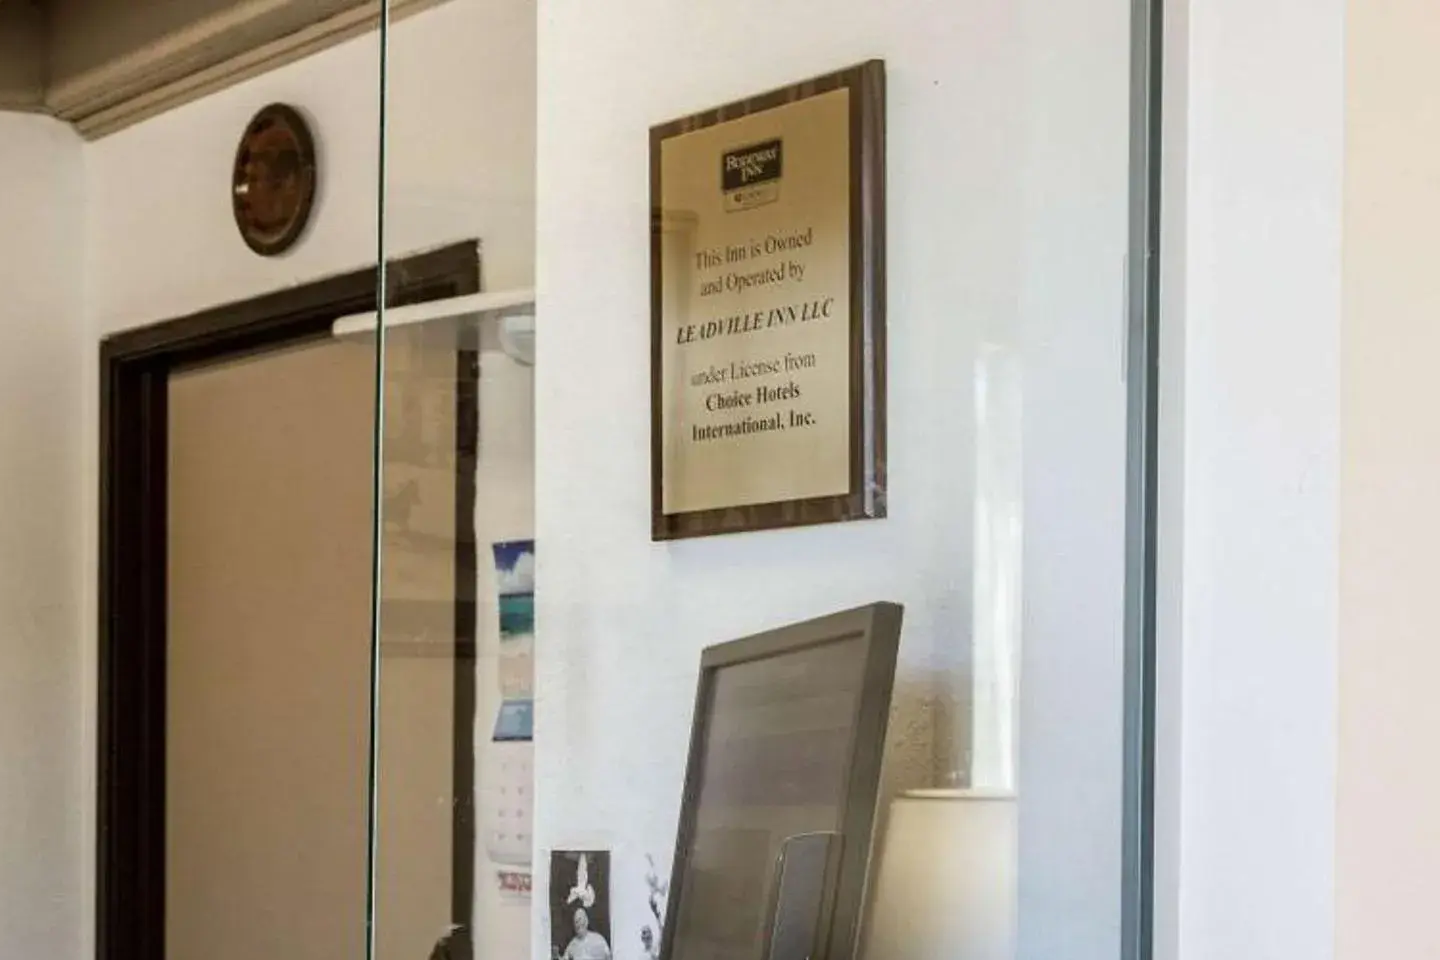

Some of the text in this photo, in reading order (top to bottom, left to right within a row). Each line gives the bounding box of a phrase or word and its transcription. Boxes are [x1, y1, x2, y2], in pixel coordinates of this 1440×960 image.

[696, 226, 812, 270] This Inn is Owned
[701, 260, 805, 296] and Operated by
[676, 298, 834, 345] LEADVILLE INN LLC
[691, 351, 816, 386] under License from
[706, 381, 800, 412] Choice Hotels
[692, 408, 816, 442] International, Inc.
